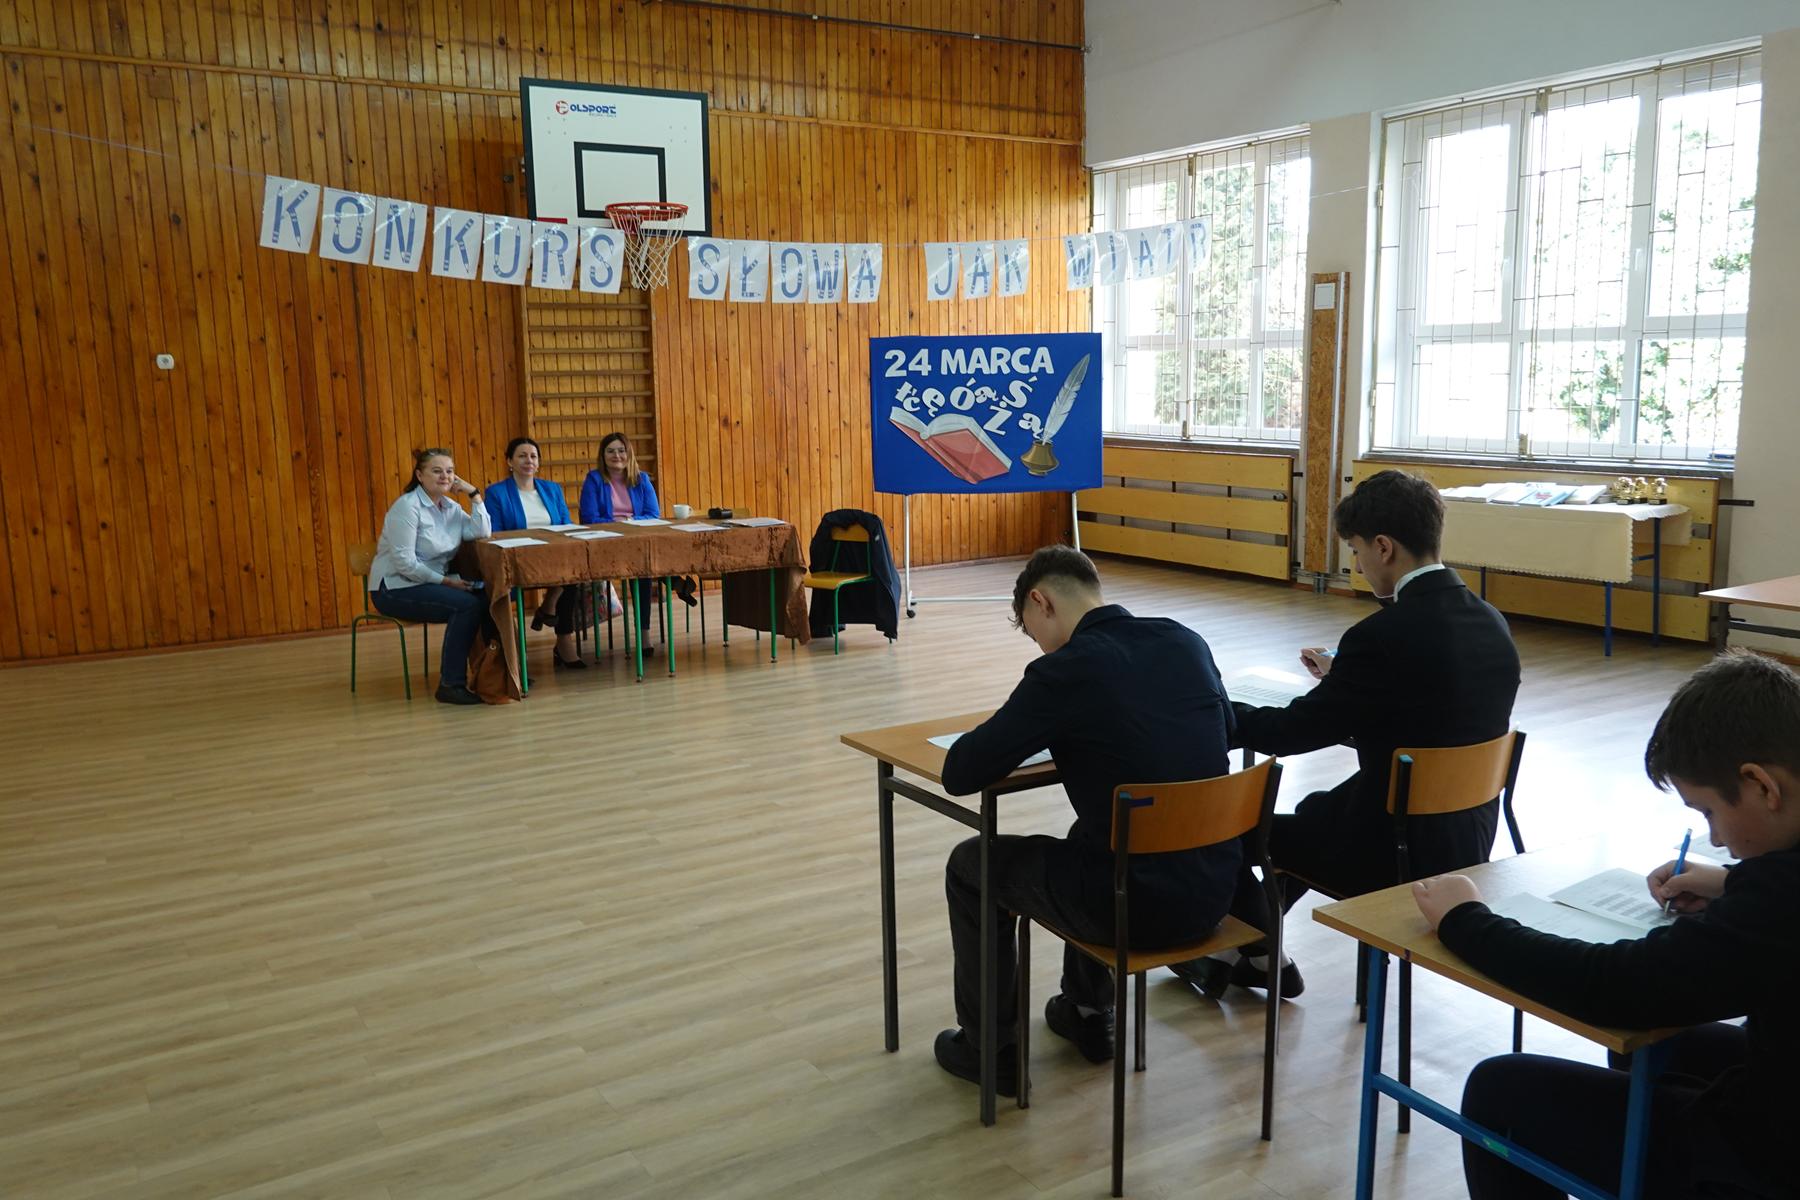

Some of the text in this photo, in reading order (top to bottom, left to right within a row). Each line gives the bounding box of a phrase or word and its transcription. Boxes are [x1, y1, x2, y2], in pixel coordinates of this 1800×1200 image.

[271, 183, 1206, 299] KONKURS SŁOWA JAK WIATR
[884, 346, 1055, 377] 24 MARCA
